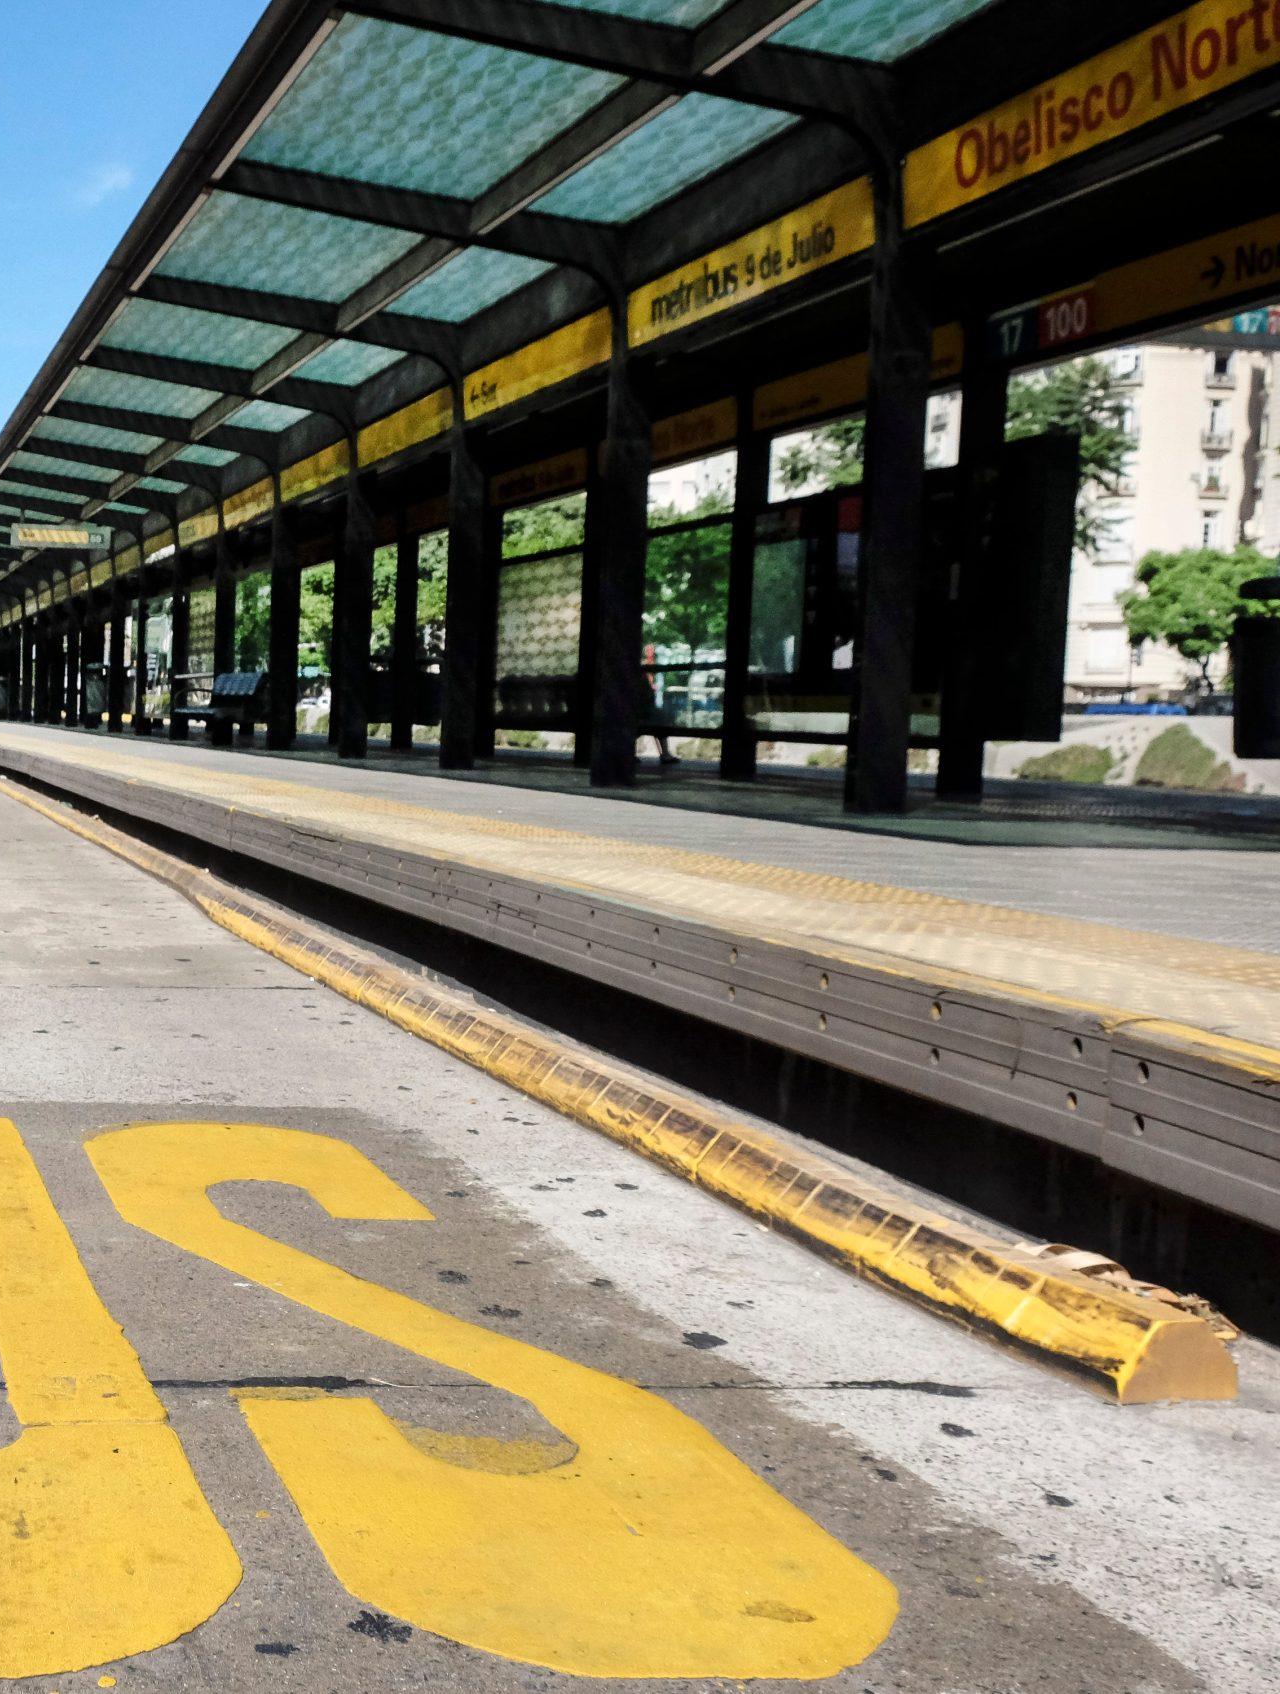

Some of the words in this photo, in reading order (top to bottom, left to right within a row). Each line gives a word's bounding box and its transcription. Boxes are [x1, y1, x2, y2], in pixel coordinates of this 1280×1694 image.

[954, 71, 1135, 188] Obelisco
[745, 253, 755, 287] 9
[760, 244, 782, 280] de
[787, 219, 835, 269] Julio
[1235, 242, 1280, 281] No
[999, 317, 1023, 354] 17
[1046, 297, 1088, 341] 100
